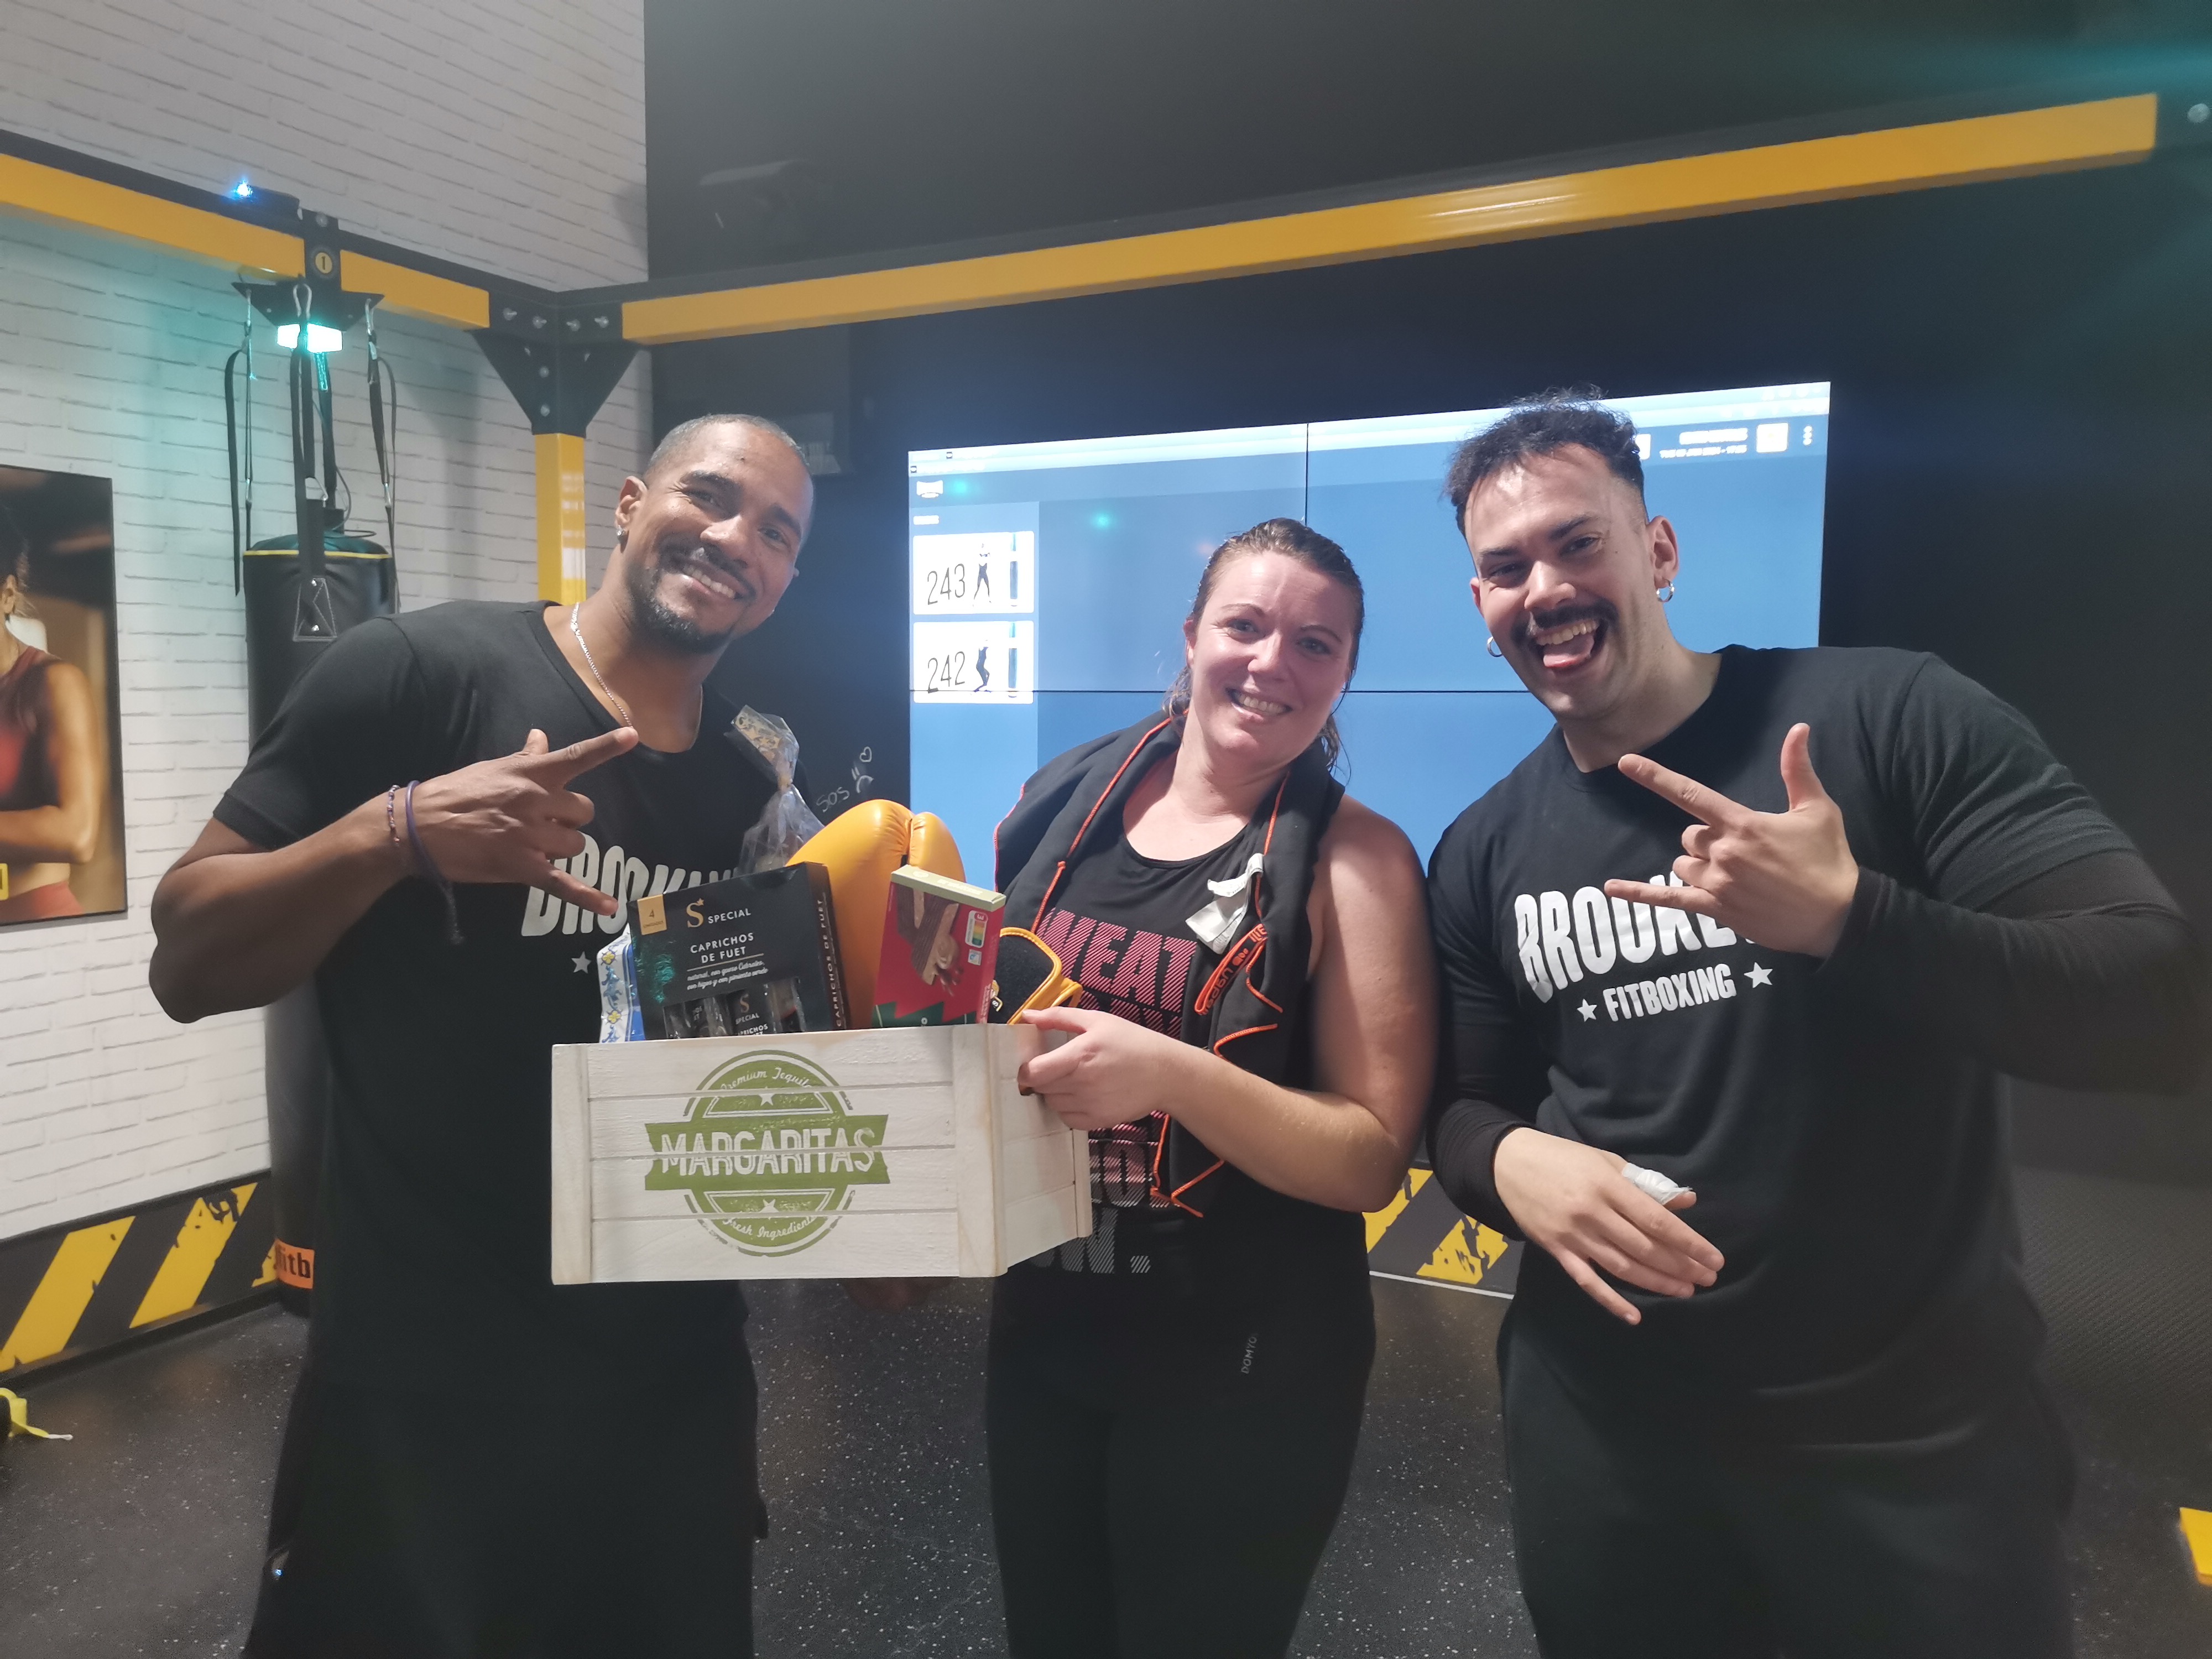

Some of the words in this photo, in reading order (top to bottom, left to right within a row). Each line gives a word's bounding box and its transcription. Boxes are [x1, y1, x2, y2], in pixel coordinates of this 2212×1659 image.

[927, 563, 965, 606] 243
[927, 651, 966, 694] 242
[649, 910, 655, 918] 4
[708, 908, 751, 924] SPECIAL
[690, 932, 754, 953] CAPRICHOS
[701, 953, 715, 964] DE
[720, 946, 746, 960] FUET
[1603, 963, 1736, 1022] FITBOXING
[661, 1128, 875, 1176] MARGARITAS
